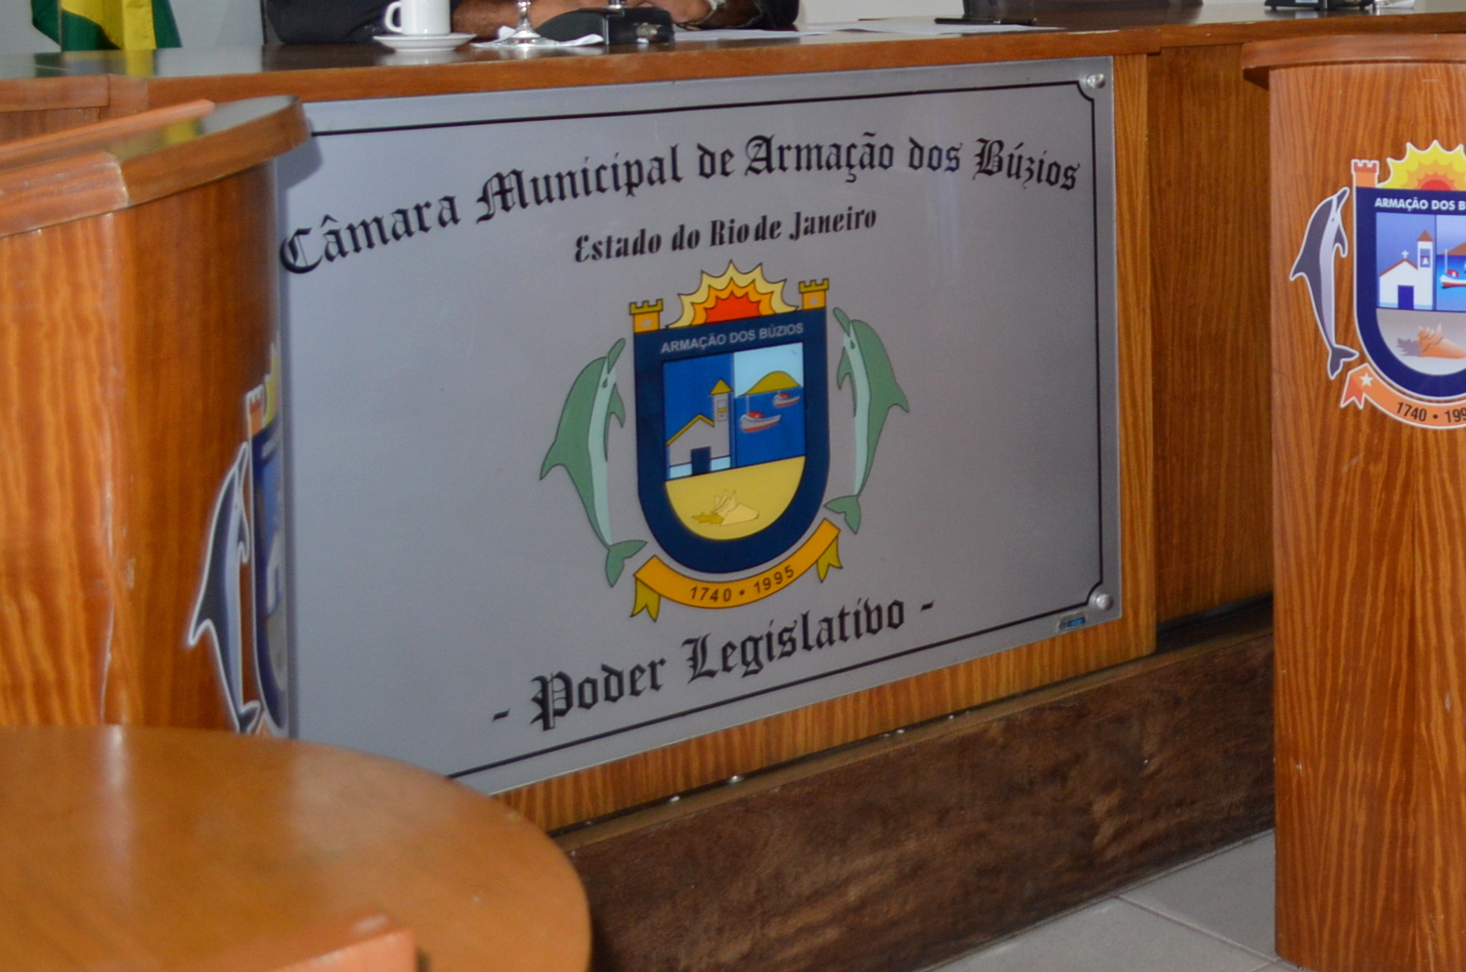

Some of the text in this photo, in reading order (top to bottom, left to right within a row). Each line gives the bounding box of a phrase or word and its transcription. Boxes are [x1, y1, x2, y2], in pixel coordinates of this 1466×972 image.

[279, 132, 1080, 274] Câmara Municipal de Armação dos Búzios
[1374, 196, 1430, 212] ARMAÇÃO
[1431, 198, 1457, 211] DOS
[574, 205, 877, 263] Estado do Rio de Janeiro
[661, 323, 804, 354] ARMAÇÃO DOS BÚZIOS
[1396, 401, 1428, 422] 1740
[690, 564, 795, 603] 1740 1995
[530, 657, 666, 732] Poder
[681, 597, 906, 685] Legislativo
